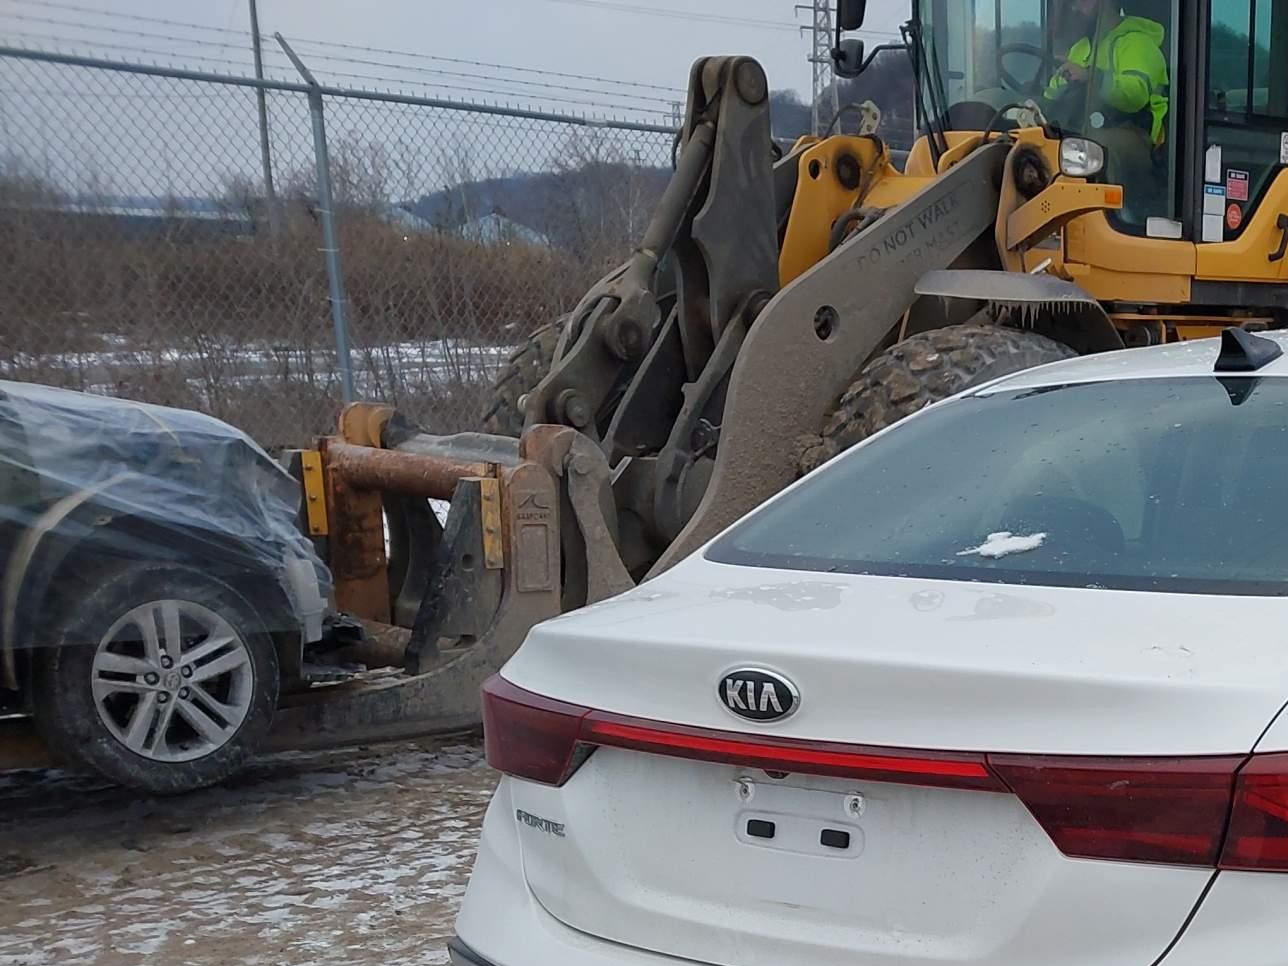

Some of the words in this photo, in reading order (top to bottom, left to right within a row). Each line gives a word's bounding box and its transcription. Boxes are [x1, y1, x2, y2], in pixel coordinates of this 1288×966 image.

[883, 220, 916, 254] NOT
[725, 677, 784, 714] KIA
[516, 808, 566, 838] FORTE
